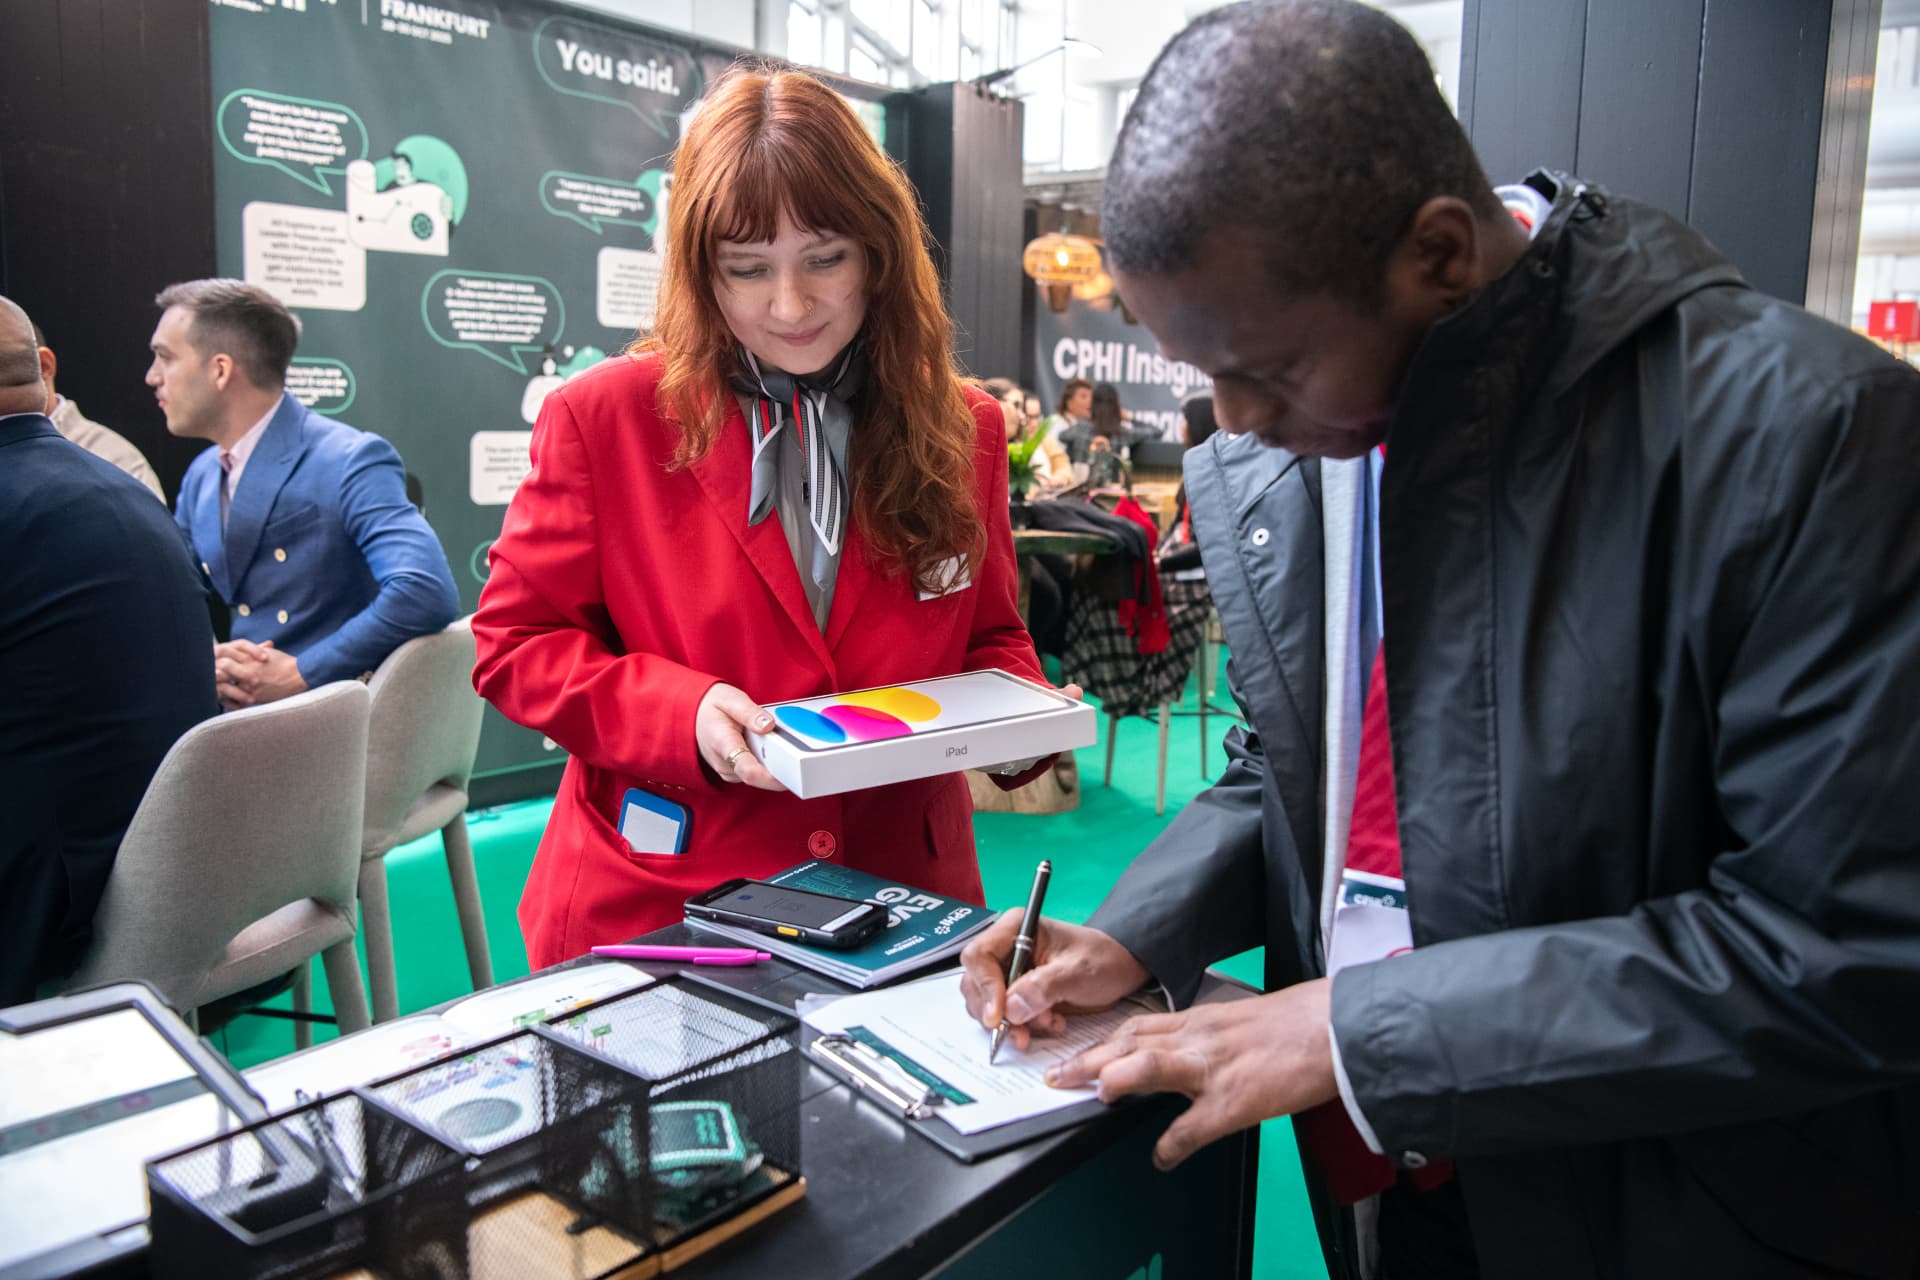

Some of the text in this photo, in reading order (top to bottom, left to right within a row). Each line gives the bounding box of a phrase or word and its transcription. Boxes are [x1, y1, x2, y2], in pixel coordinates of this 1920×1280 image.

[381, 0, 490, 39] FRANKFURT
[556, 38, 680, 96] You said.
[1053, 337, 1124, 383] CPHI
[945, 744, 968, 758] iPad
[938, 906, 973, 926] CPHI
